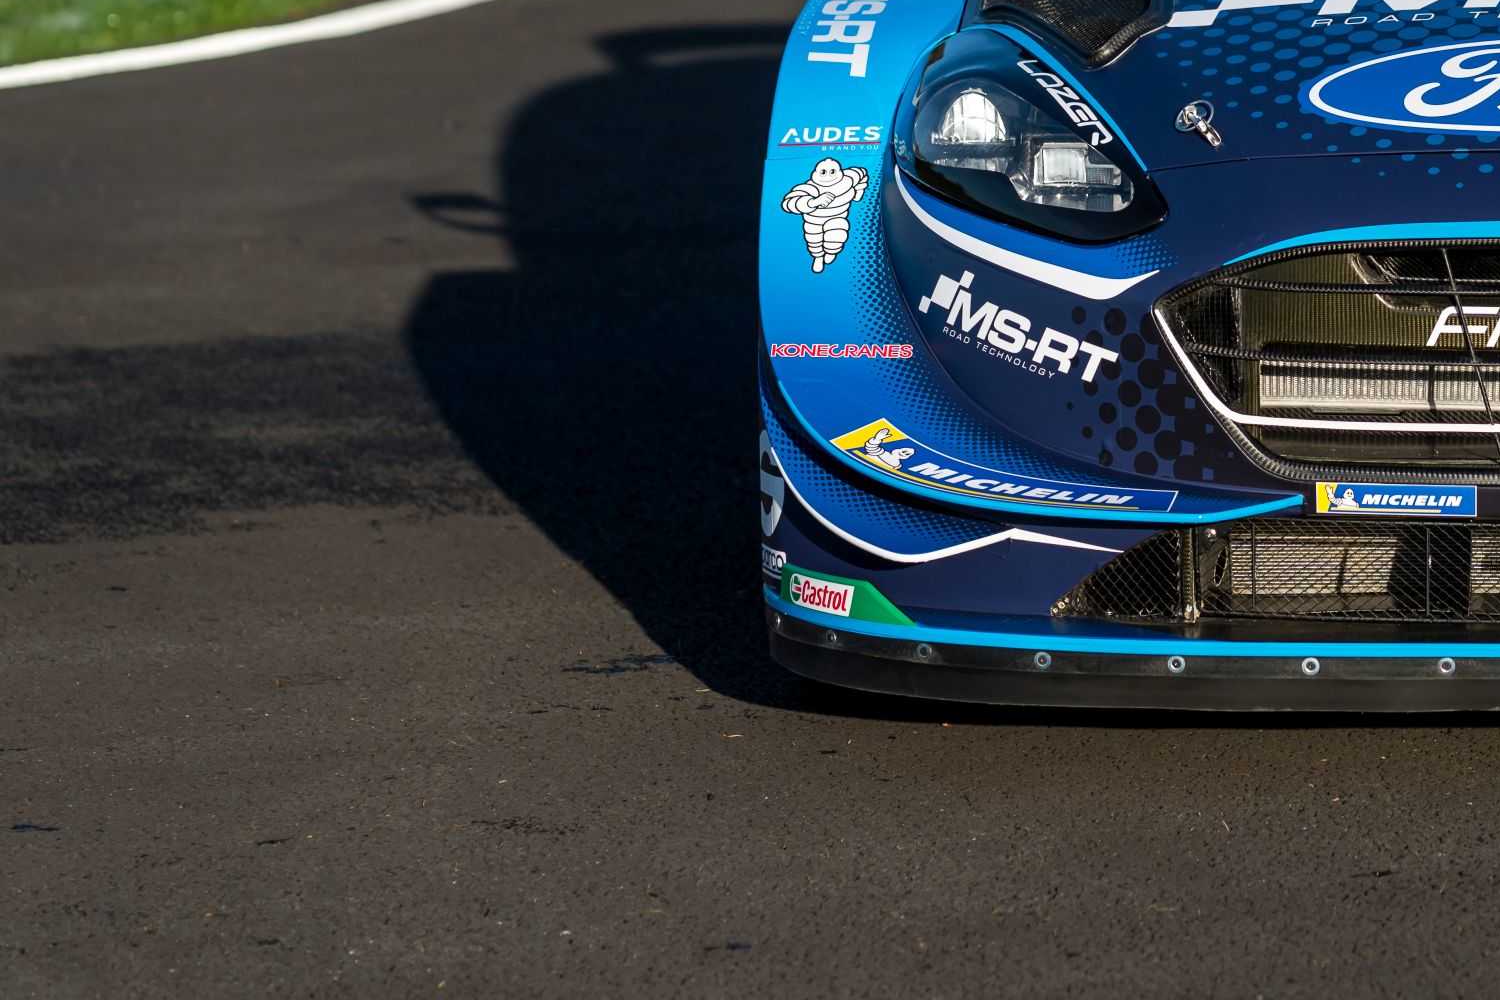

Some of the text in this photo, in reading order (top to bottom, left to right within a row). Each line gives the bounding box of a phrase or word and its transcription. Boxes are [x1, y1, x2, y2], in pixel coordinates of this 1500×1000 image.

[1311, 12, 1435, 28] ROAD
[1016, 60, 1113, 146] LAZER
[783, 126, 881, 143] AUDES
[770, 343, 914, 359] KONECRANES
[946, 289, 1120, 383] MS-RT
[942, 326, 1056, 380] ROAD TECHNOLOGY
[908, 461, 1135, 506] MICHELIN
[1362, 494, 1463, 507] MICHELIN
[801, 580, 849, 612] Castrol
